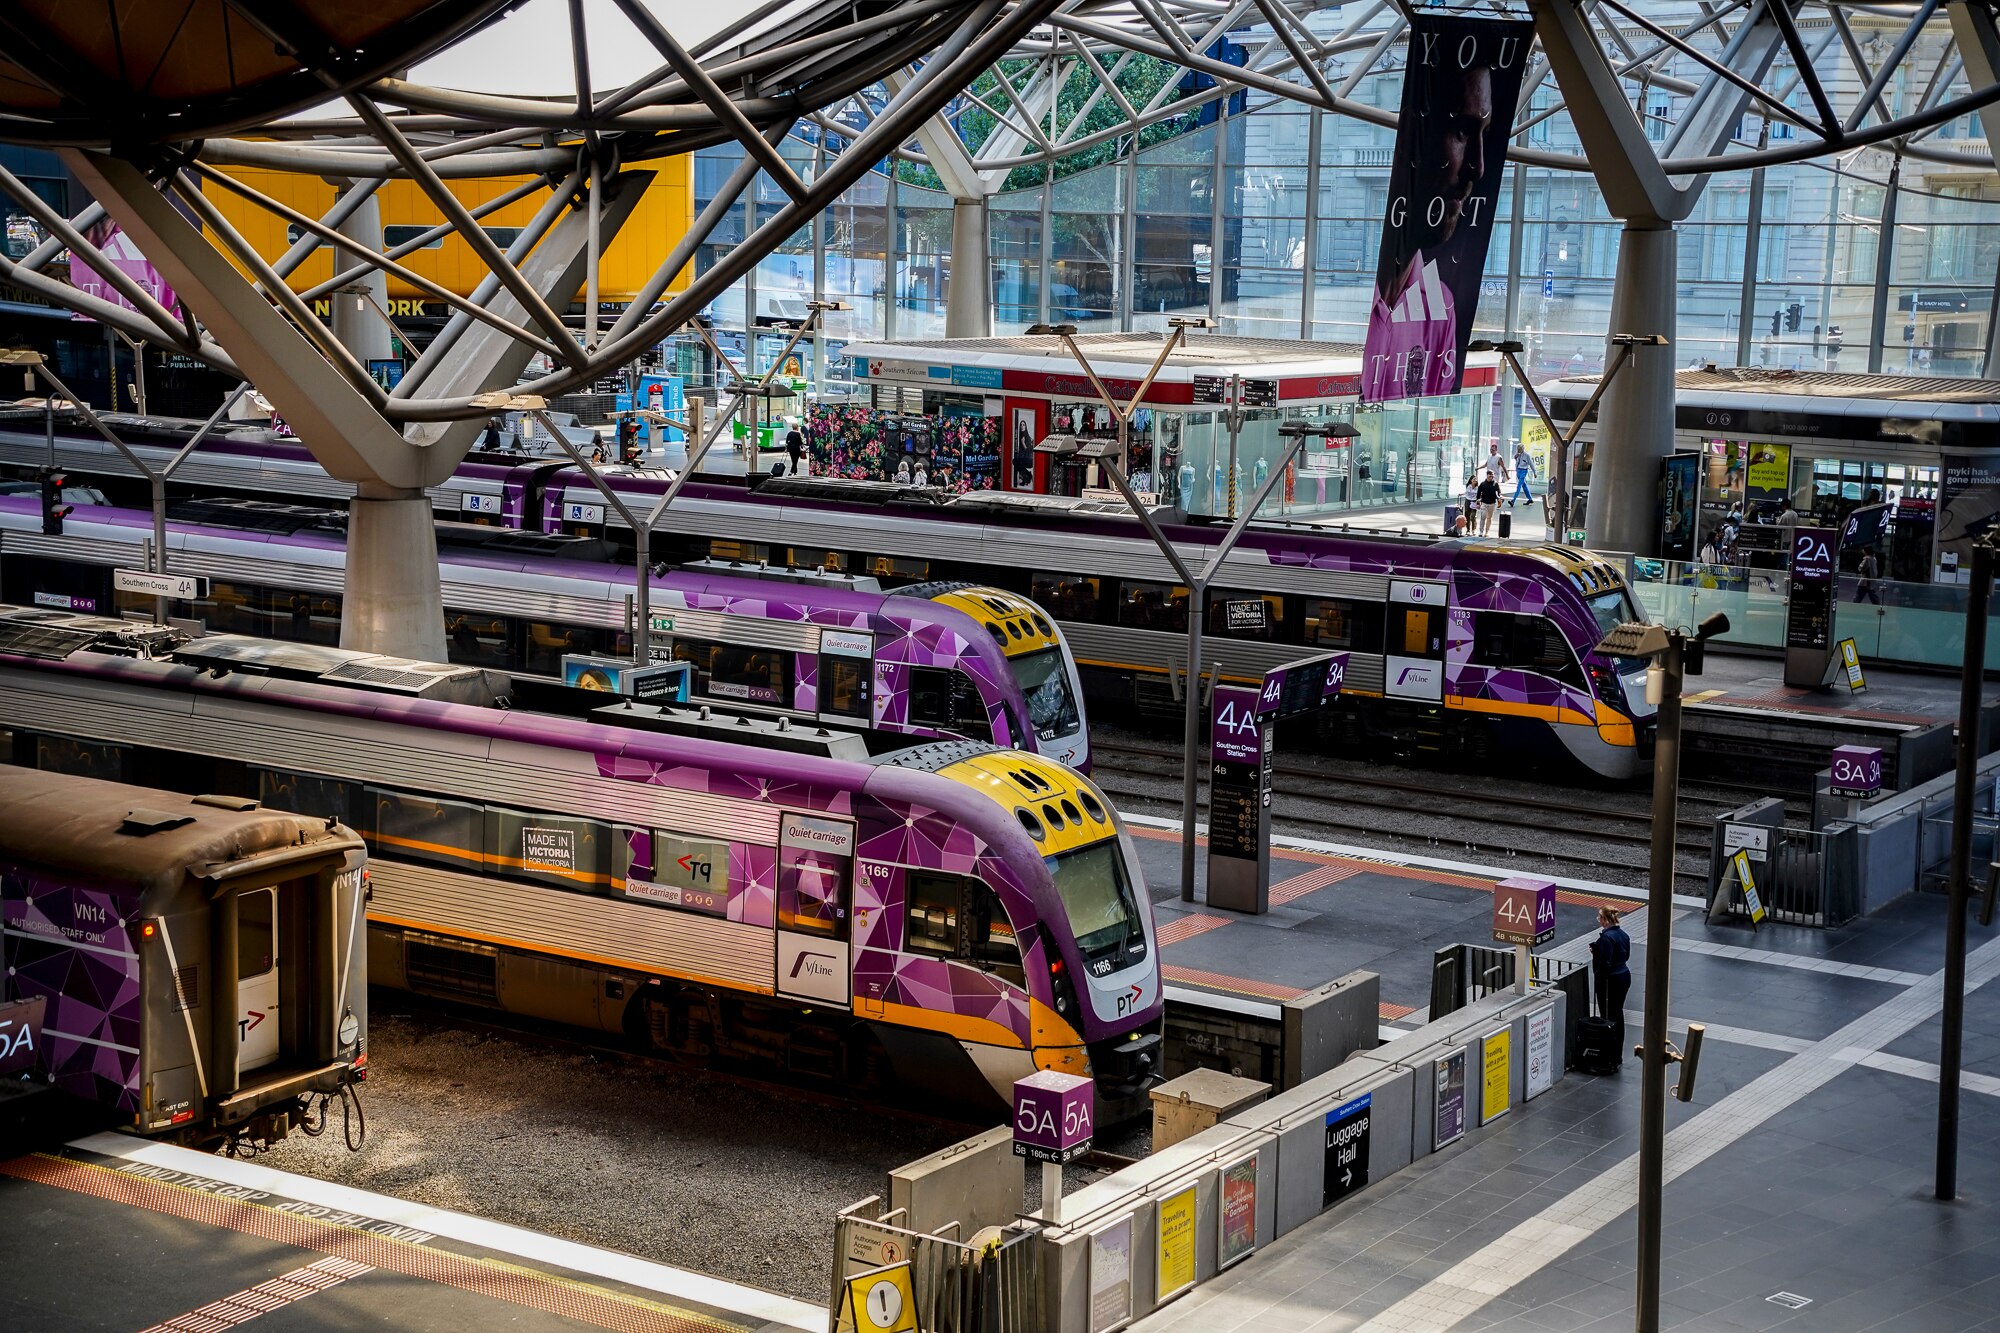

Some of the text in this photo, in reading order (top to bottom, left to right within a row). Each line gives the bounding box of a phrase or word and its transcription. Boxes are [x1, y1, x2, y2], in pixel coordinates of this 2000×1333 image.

[883, 366, 927, 376] Southern Telecom
[1045, 376, 1095, 394] Catwalk
[1431, 428, 1450, 437] SALE
[1948, 467, 1988, 478] myki has
[1946, 476, 1968, 485] gone
[1664, 471, 1675, 533] CHANDON
[1847, 517, 1857, 535] 2A
[1796, 536, 1830, 562] 2A
[122, 577, 192, 595] Southern Cross 4A
[1230, 603, 1260, 612] MADE IN
[1231, 611, 1262, 619] VICTORIA
[1453, 611, 1471, 619] 1193
[826, 639, 868, 651] Quiet carriage
[660, 650, 667, 659] IN
[877, 663, 894, 673] 1172
[1326, 662, 1344, 686] 3A
[638, 688, 664, 697] Experience
[669, 685, 680, 693] here.
[710, 683, 747, 695] Quiet carriage
[1262, 680, 1280, 702] 4A
[1217, 701, 1258, 737] 4A
[1040, 729, 1056, 740] 1172
[1216, 741, 1258, 753] Southern Cross
[1226, 749, 1247, 758] Station
[1214, 764, 1227, 775] 4B
[1835, 759, 1866, 783] 3A
[1869, 760, 1881, 782] 3A
[1832, 787, 1841, 795] 3B
[528, 833, 568, 847] MADE IN
[788, 825, 847, 845] Quiet carriage
[1729, 829, 1750, 837] Authorised
[528, 846, 571, 859] VICTORIA
[528, 857, 571, 868] FOR VICTORIA
[860, 863, 889, 878] 1166
[629, 882, 679, 900] Quiet carriage
[74, 902, 106, 924] VN14
[1498, 897, 1532, 926] 4A
[1537, 898, 1554, 924] 4A
[11, 917, 106, 944] AUTHORISED STAFF ONLY
[1495, 931, 1525, 943] 4B 160m
[1093, 959, 1111, 975] 1166
[1117, 993, 1134, 1018] PT
[238, 1019, 250, 1042] T
[177, 1101, 189, 1109] END
[1018, 1098, 1058, 1138] 5A
[1064, 1100, 1090, 1136] 5A
[1326, 1116, 1369, 1149] Luggage
[1015, 1144, 1050, 1159] 5B 160m
[1063, 1146, 1085, 1161] 5B 160m
[1337, 1142, 1357, 1167] Hall
[117, 1162, 270, 1201] MIND THE GAP
[1162, 1208, 1186, 1226] Travelling
[1229, 1203, 1249, 1218] Garden
[274, 1201, 437, 1243] MIND THE GAP
[1162, 1227, 1174, 1237] with
[1178, 1218, 1191, 1231] pram
[853, 1241, 872, 1251] Access
[854, 1234, 881, 1246] Authorised
[853, 1248, 866, 1257] Only
